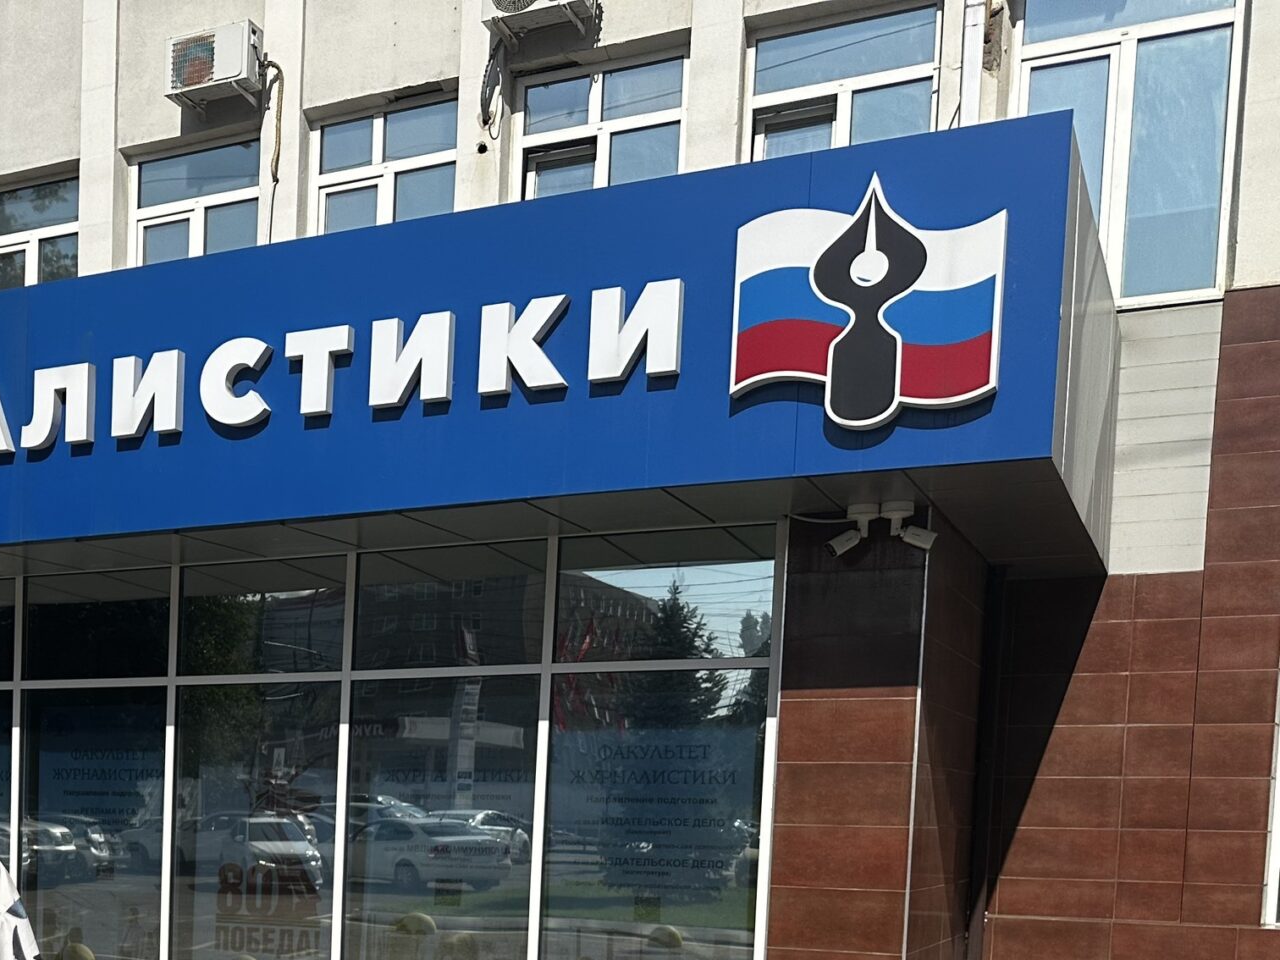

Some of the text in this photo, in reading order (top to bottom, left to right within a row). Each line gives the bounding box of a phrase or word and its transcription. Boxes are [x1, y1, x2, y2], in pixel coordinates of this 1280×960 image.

[70, 749, 146, 761] ФАКУЛЬТЕТ
[598, 744, 711, 761] ФАКУЛЬТЕТ
[569, 768, 737, 785] ЖУРНАЛИСТИКИ
[601, 817, 689, 828] ИЗДАТЕЛЬСКОЕ
[692, 818, 726, 829] ДЕЛО
[691, 859, 724, 870] ДЕЛО
[216, 862, 274, 914] 80
